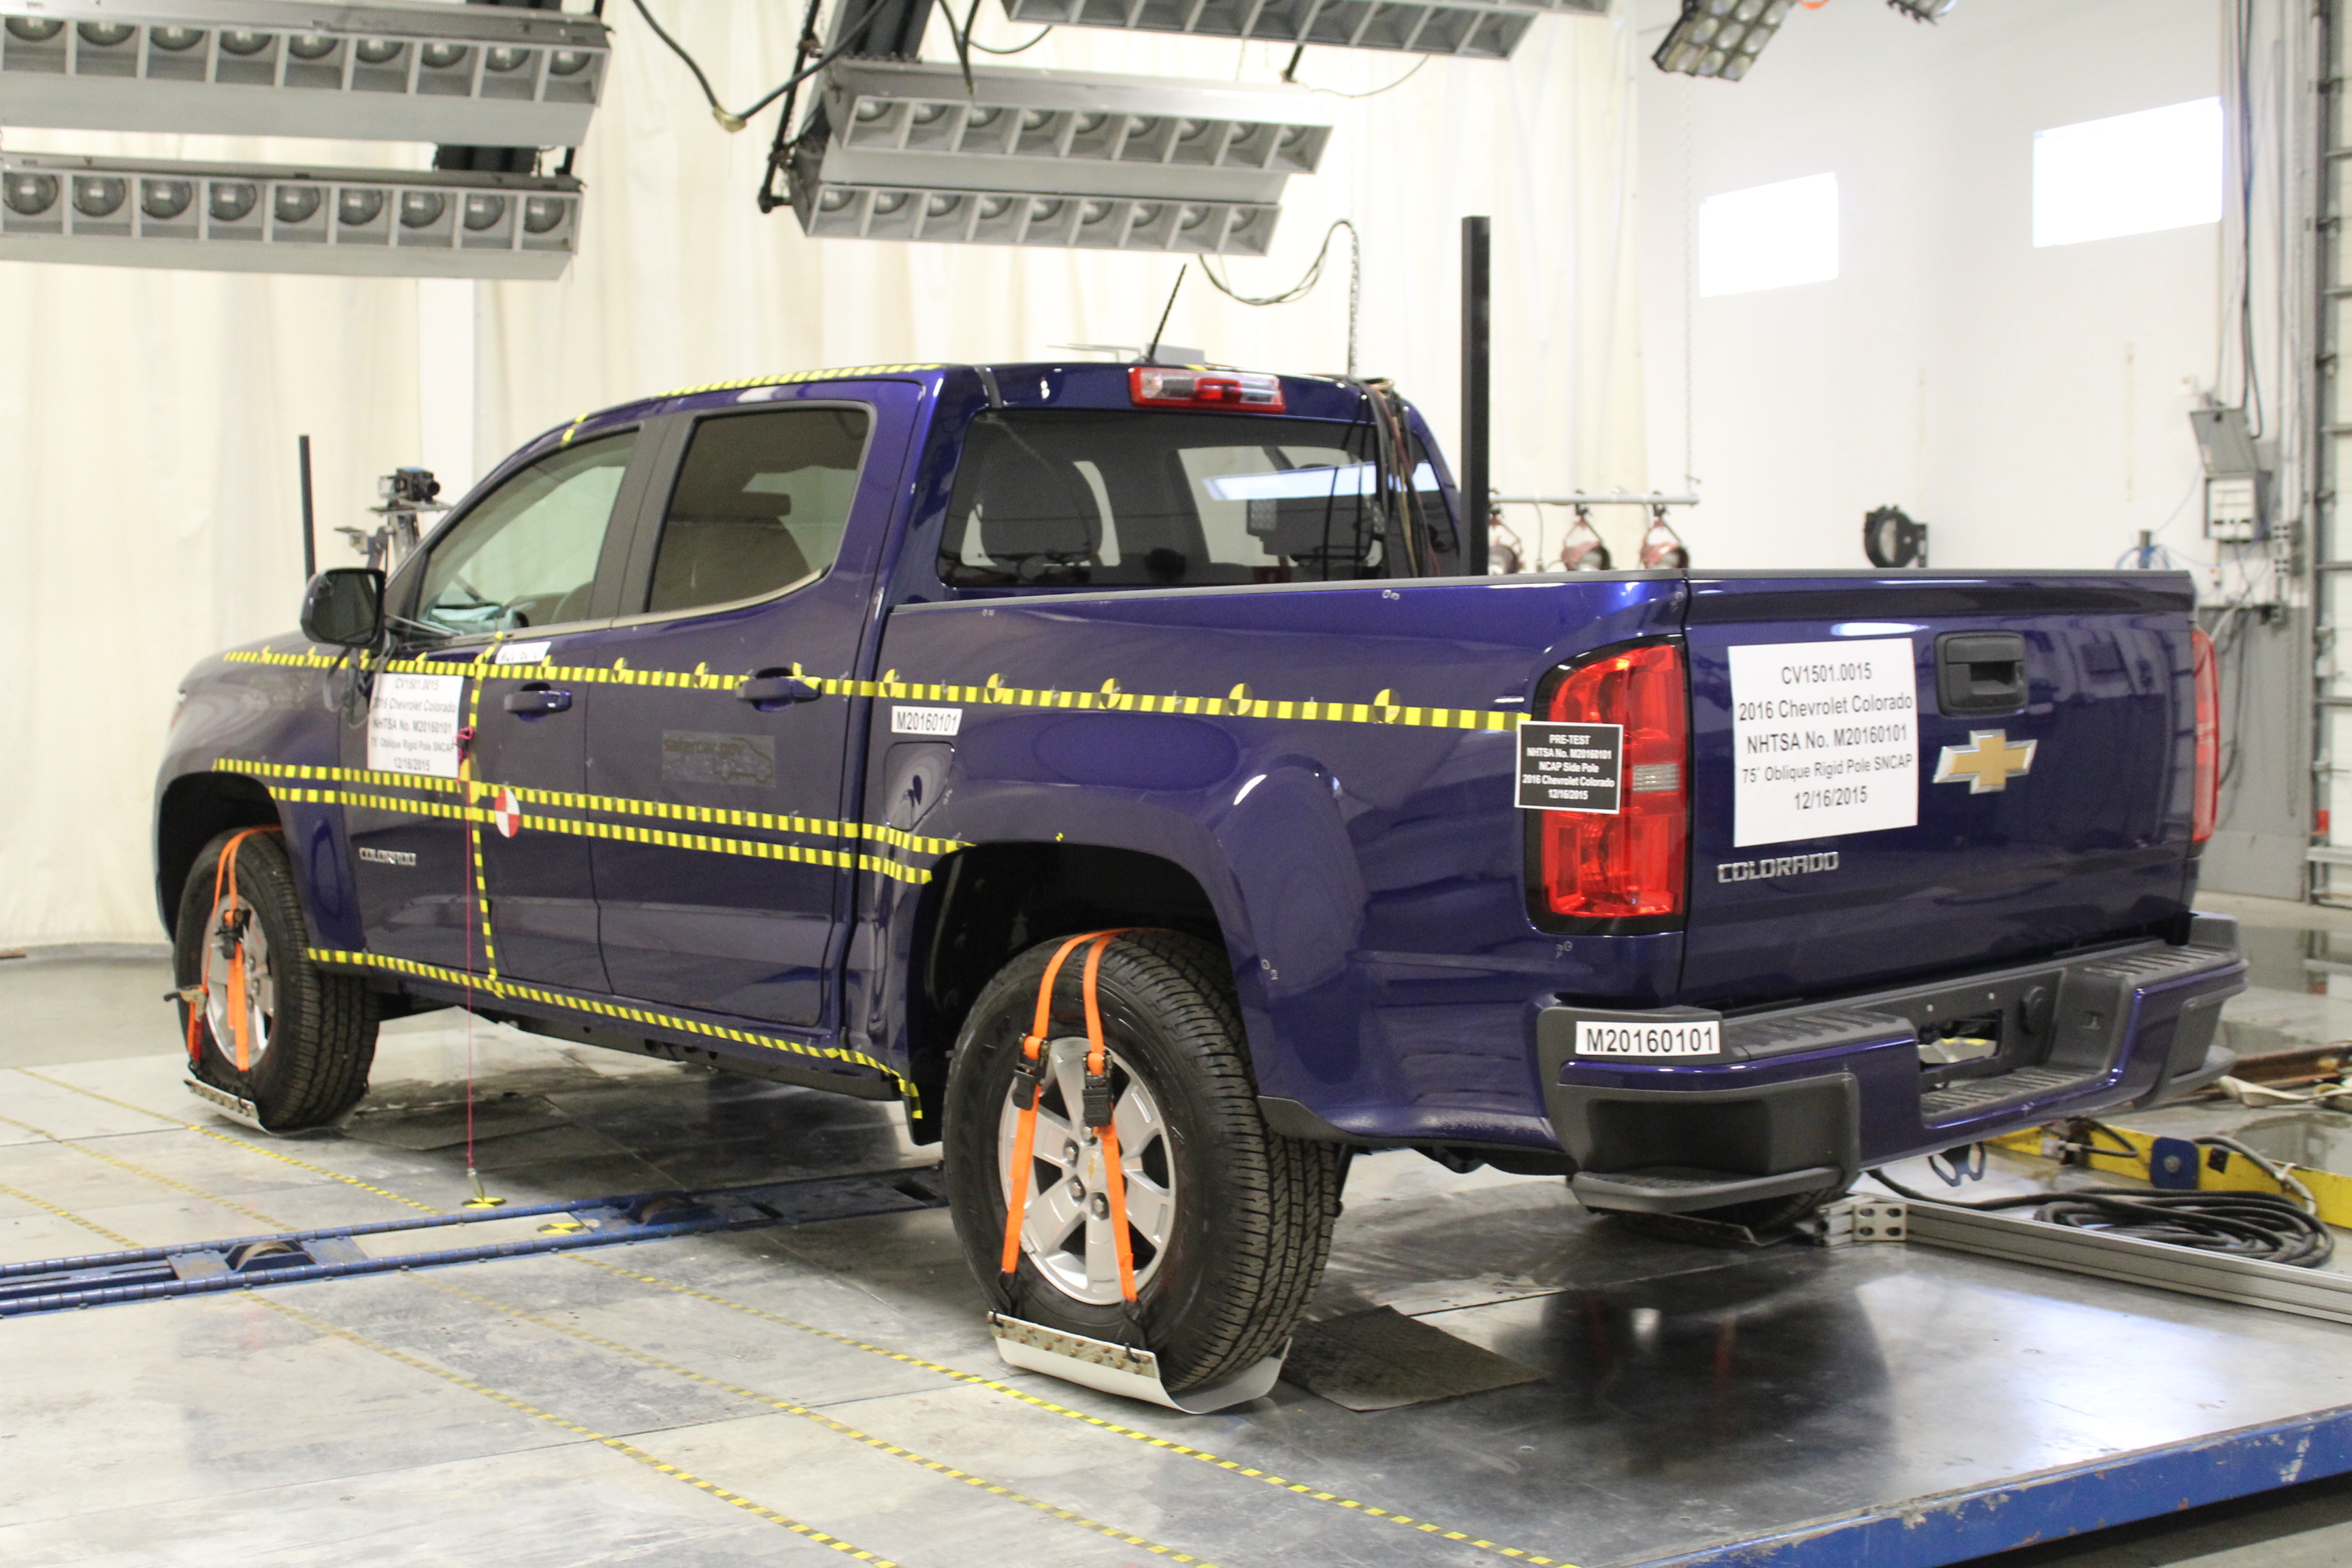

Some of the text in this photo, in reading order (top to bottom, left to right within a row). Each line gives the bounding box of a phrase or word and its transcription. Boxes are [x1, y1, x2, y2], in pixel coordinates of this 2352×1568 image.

[1782, 662, 1872, 685] CV1501.0015
[1739, 691, 1913, 721] 2016 Chevrolet Colorado
[896, 711, 958, 732] M20160101
[1548, 734, 1591, 745] PRE-TEST
[1747, 723, 1908, 754] NHTSA No. M20160101
[1526, 747, 1613, 760] NHTSA No. M20160101
[1538, 761, 1600, 773] NCAP Side Pole
[1765, 764, 1811, 783] Oblique
[1814, 760, 1844, 779] Rigid
[1847, 757, 1872, 774] Pole
[1874, 753, 1913, 771] SNCAP
[1522, 774, 1616, 787] 2016 Chevrolet Colorado
[1548, 788, 1589, 800] 12/16/2015
[1795, 785, 1868, 811] 12/16/2015
[1717, 851, 1840, 883] COLORADO
[1586, 1026, 1713, 1053] M20160101
